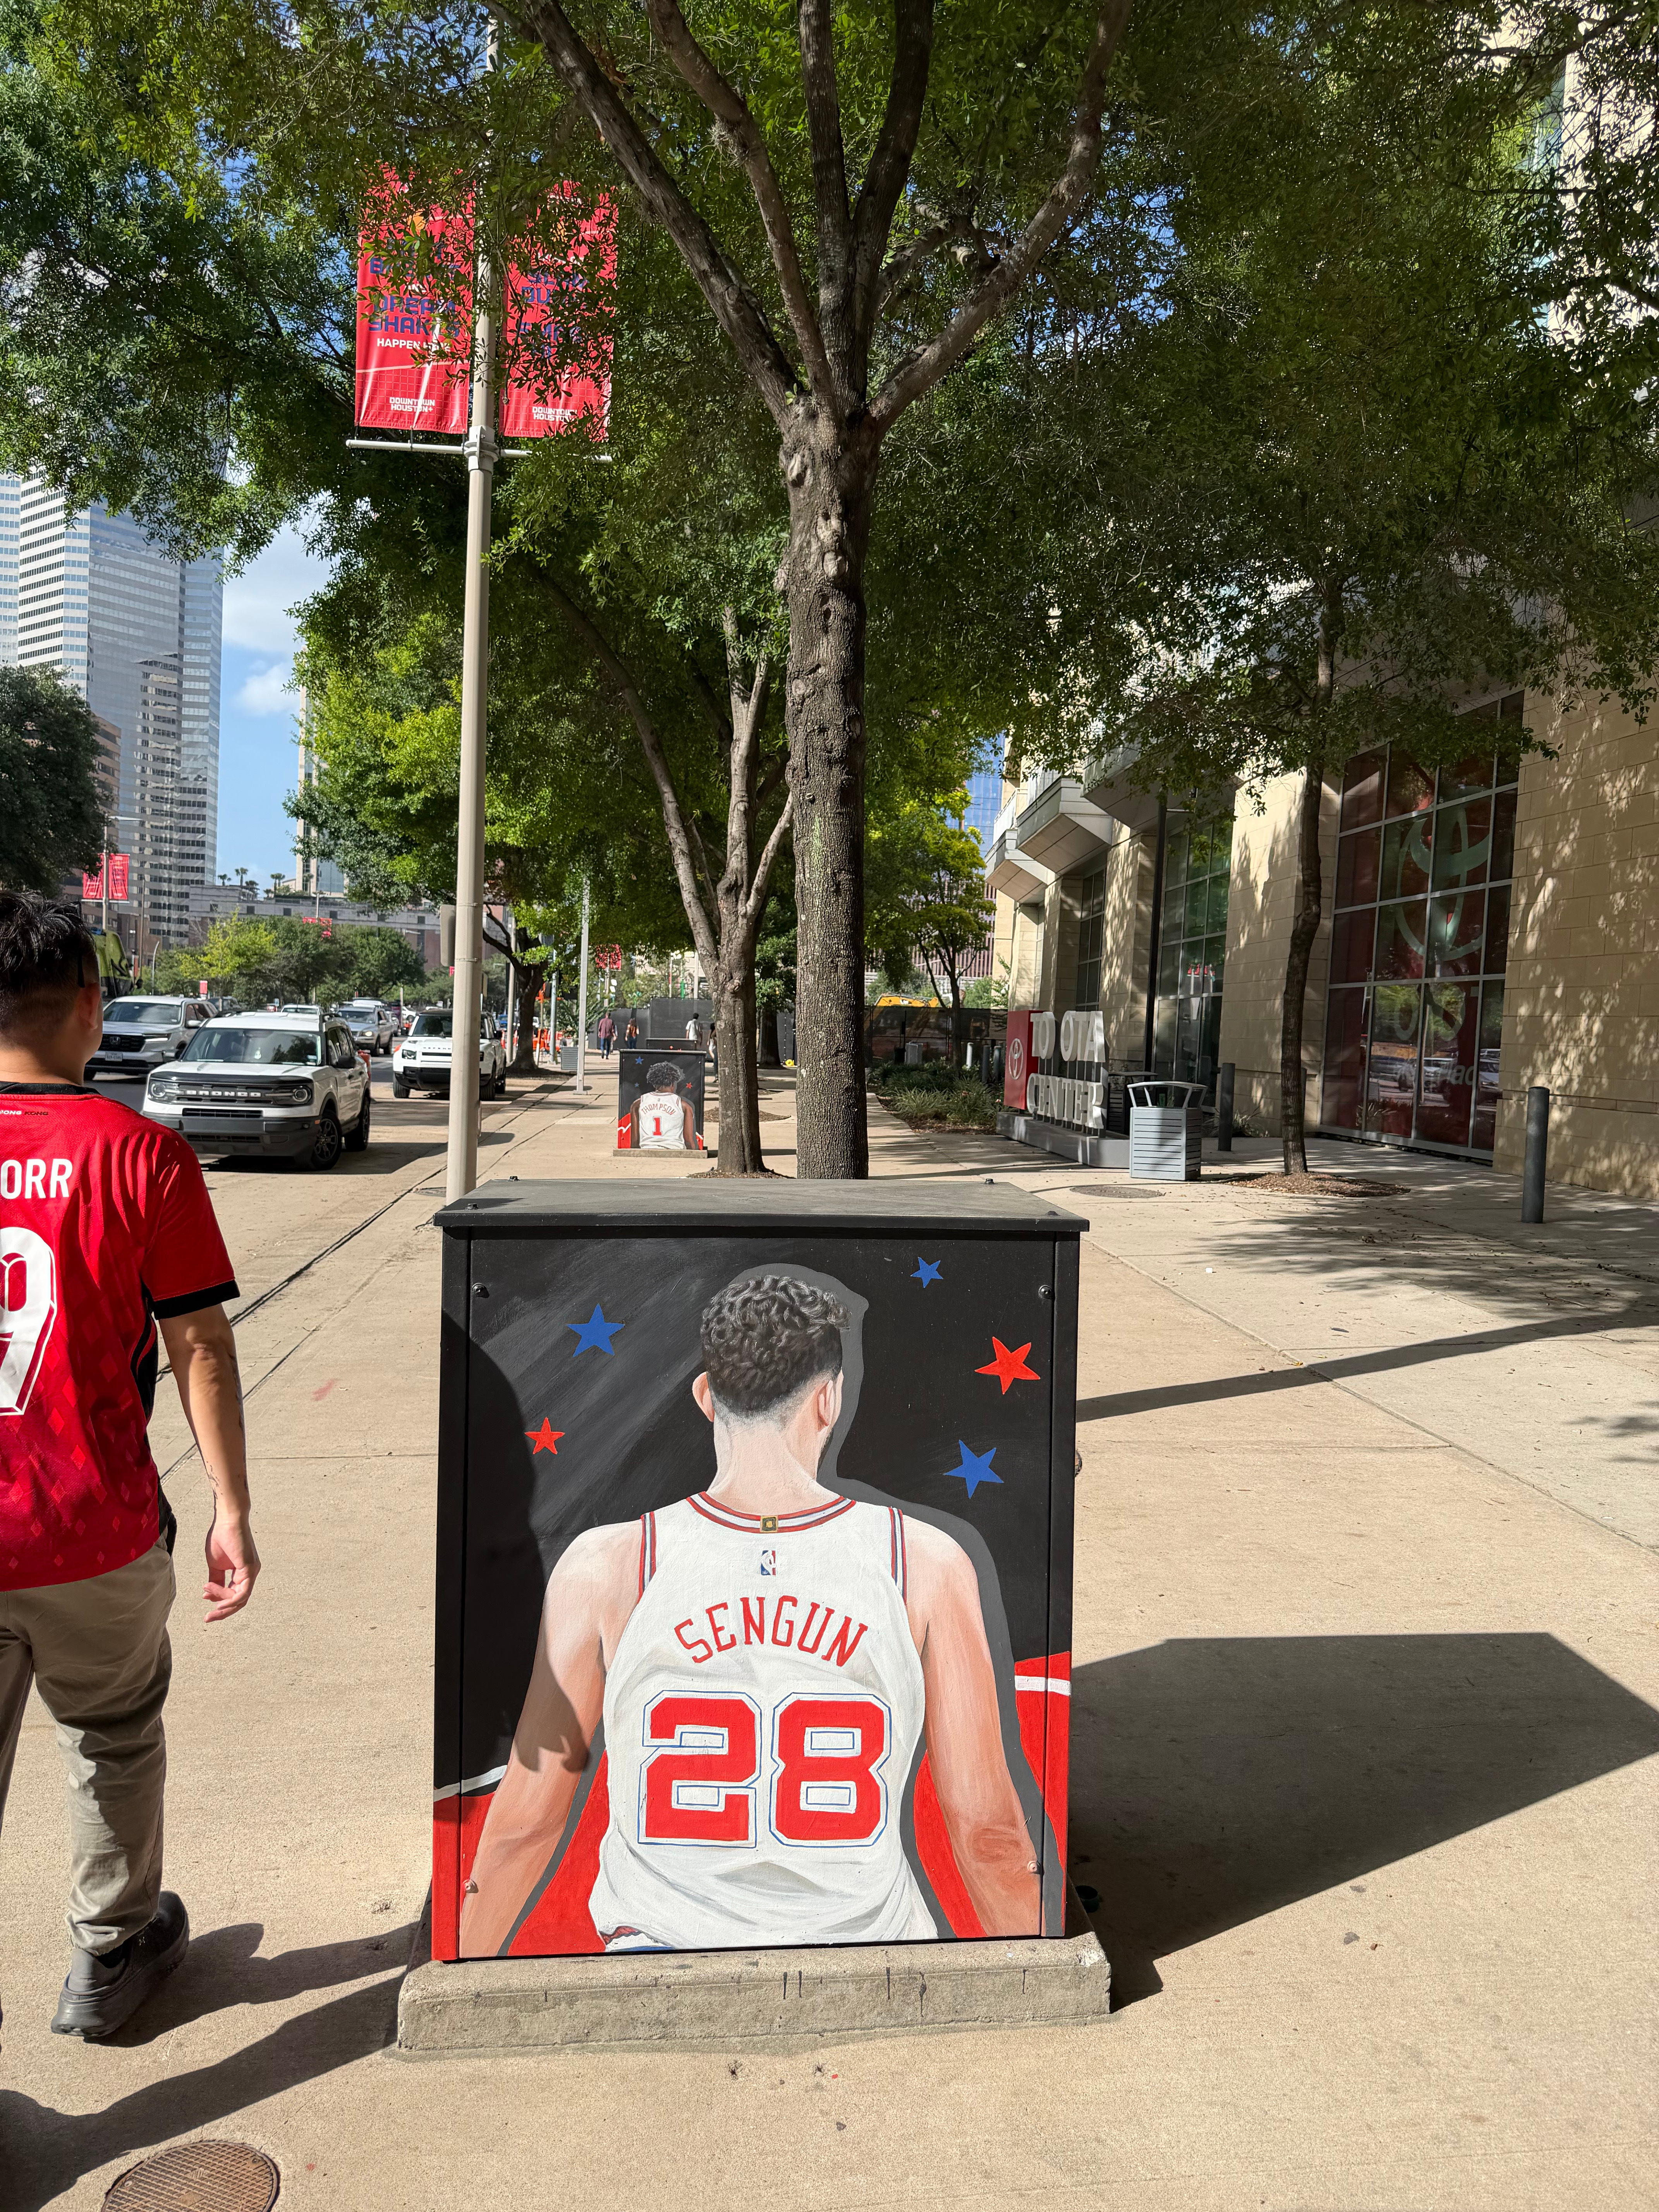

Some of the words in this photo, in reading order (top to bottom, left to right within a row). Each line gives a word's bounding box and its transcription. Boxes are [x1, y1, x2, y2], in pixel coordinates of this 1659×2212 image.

[369, 314, 460, 338] SHAKS
[377, 338, 421, 350] HAPPEN
[390, 397, 435, 406] DOWNTOWN
[1030, 1010, 1106, 1063] TOOTA
[186, 1089, 261, 1097] BRONCO
[641, 1103, 676, 1115] THOMPSON
[1027, 1073, 1104, 1129] CENTER
[652, 1116, 663, 1137] 1
[0, 1158, 73, 1199] ORR
[0, 1226, 57, 1415] 9
[674, 1595, 868, 1667] SENGUN
[637, 1690, 891, 1849] 28
